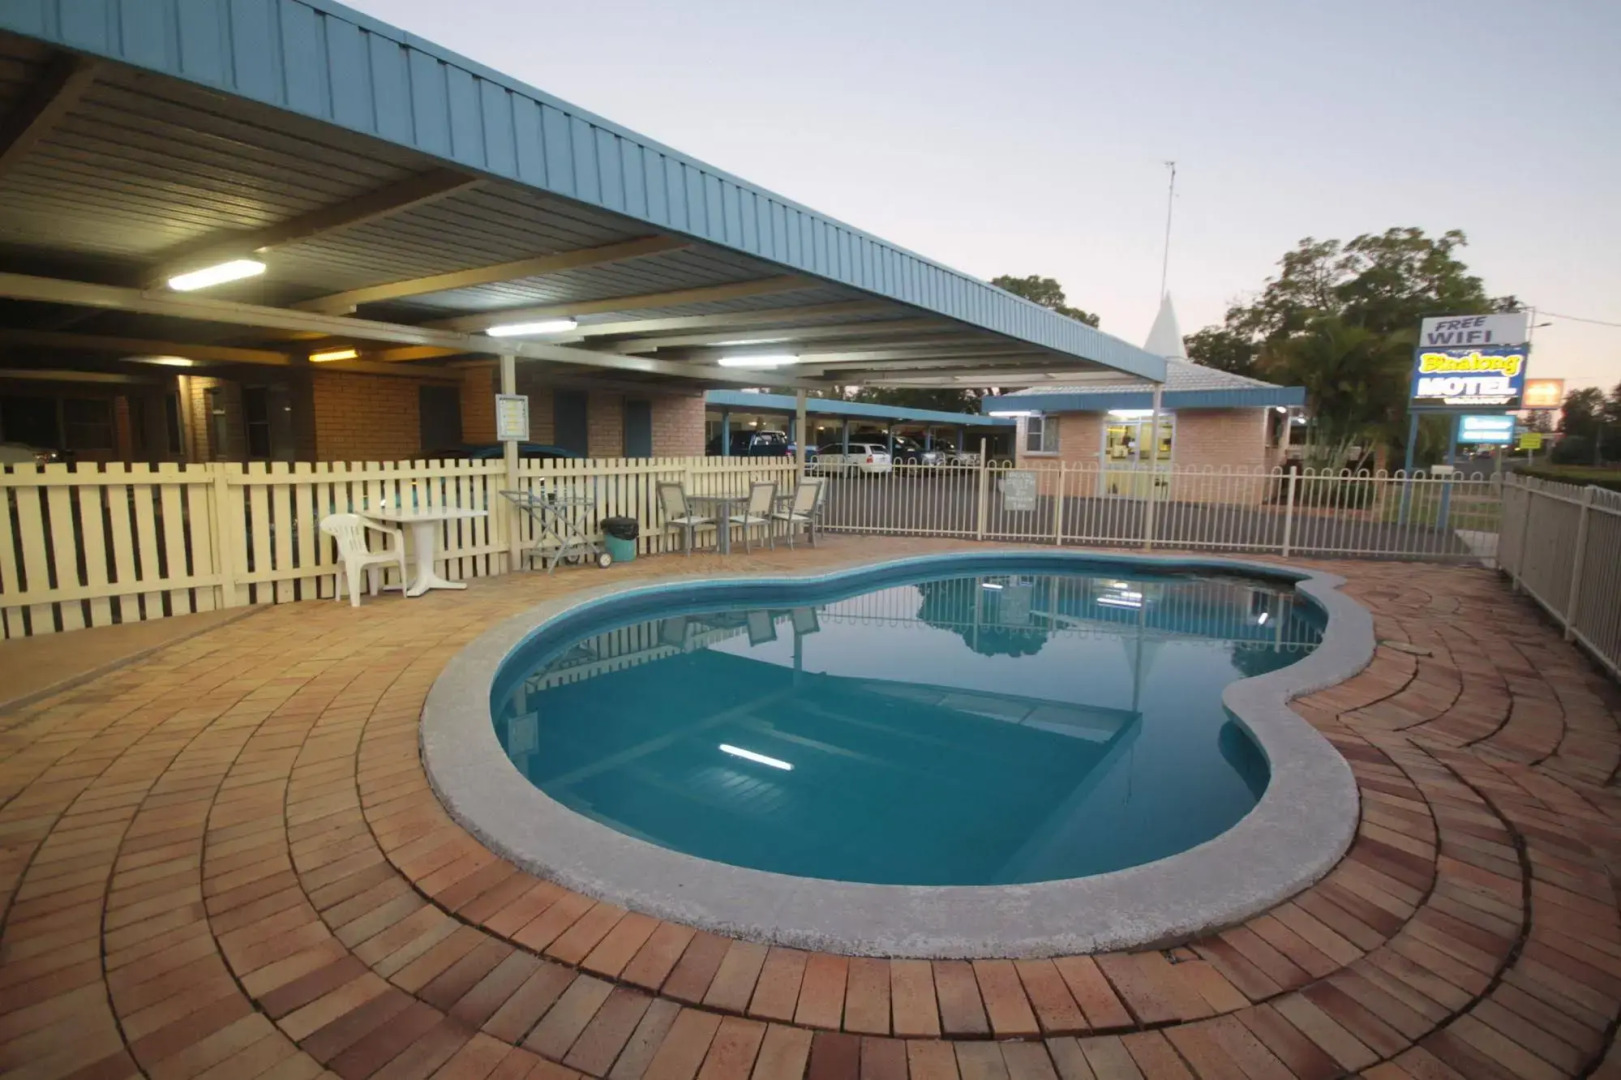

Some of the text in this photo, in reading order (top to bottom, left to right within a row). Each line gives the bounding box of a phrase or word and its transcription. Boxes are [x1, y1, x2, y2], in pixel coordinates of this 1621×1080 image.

[1435, 317, 1486, 331] FREE
[1427, 331, 1492, 344] WIFI
[1418, 377, 1517, 395] MOTEL
